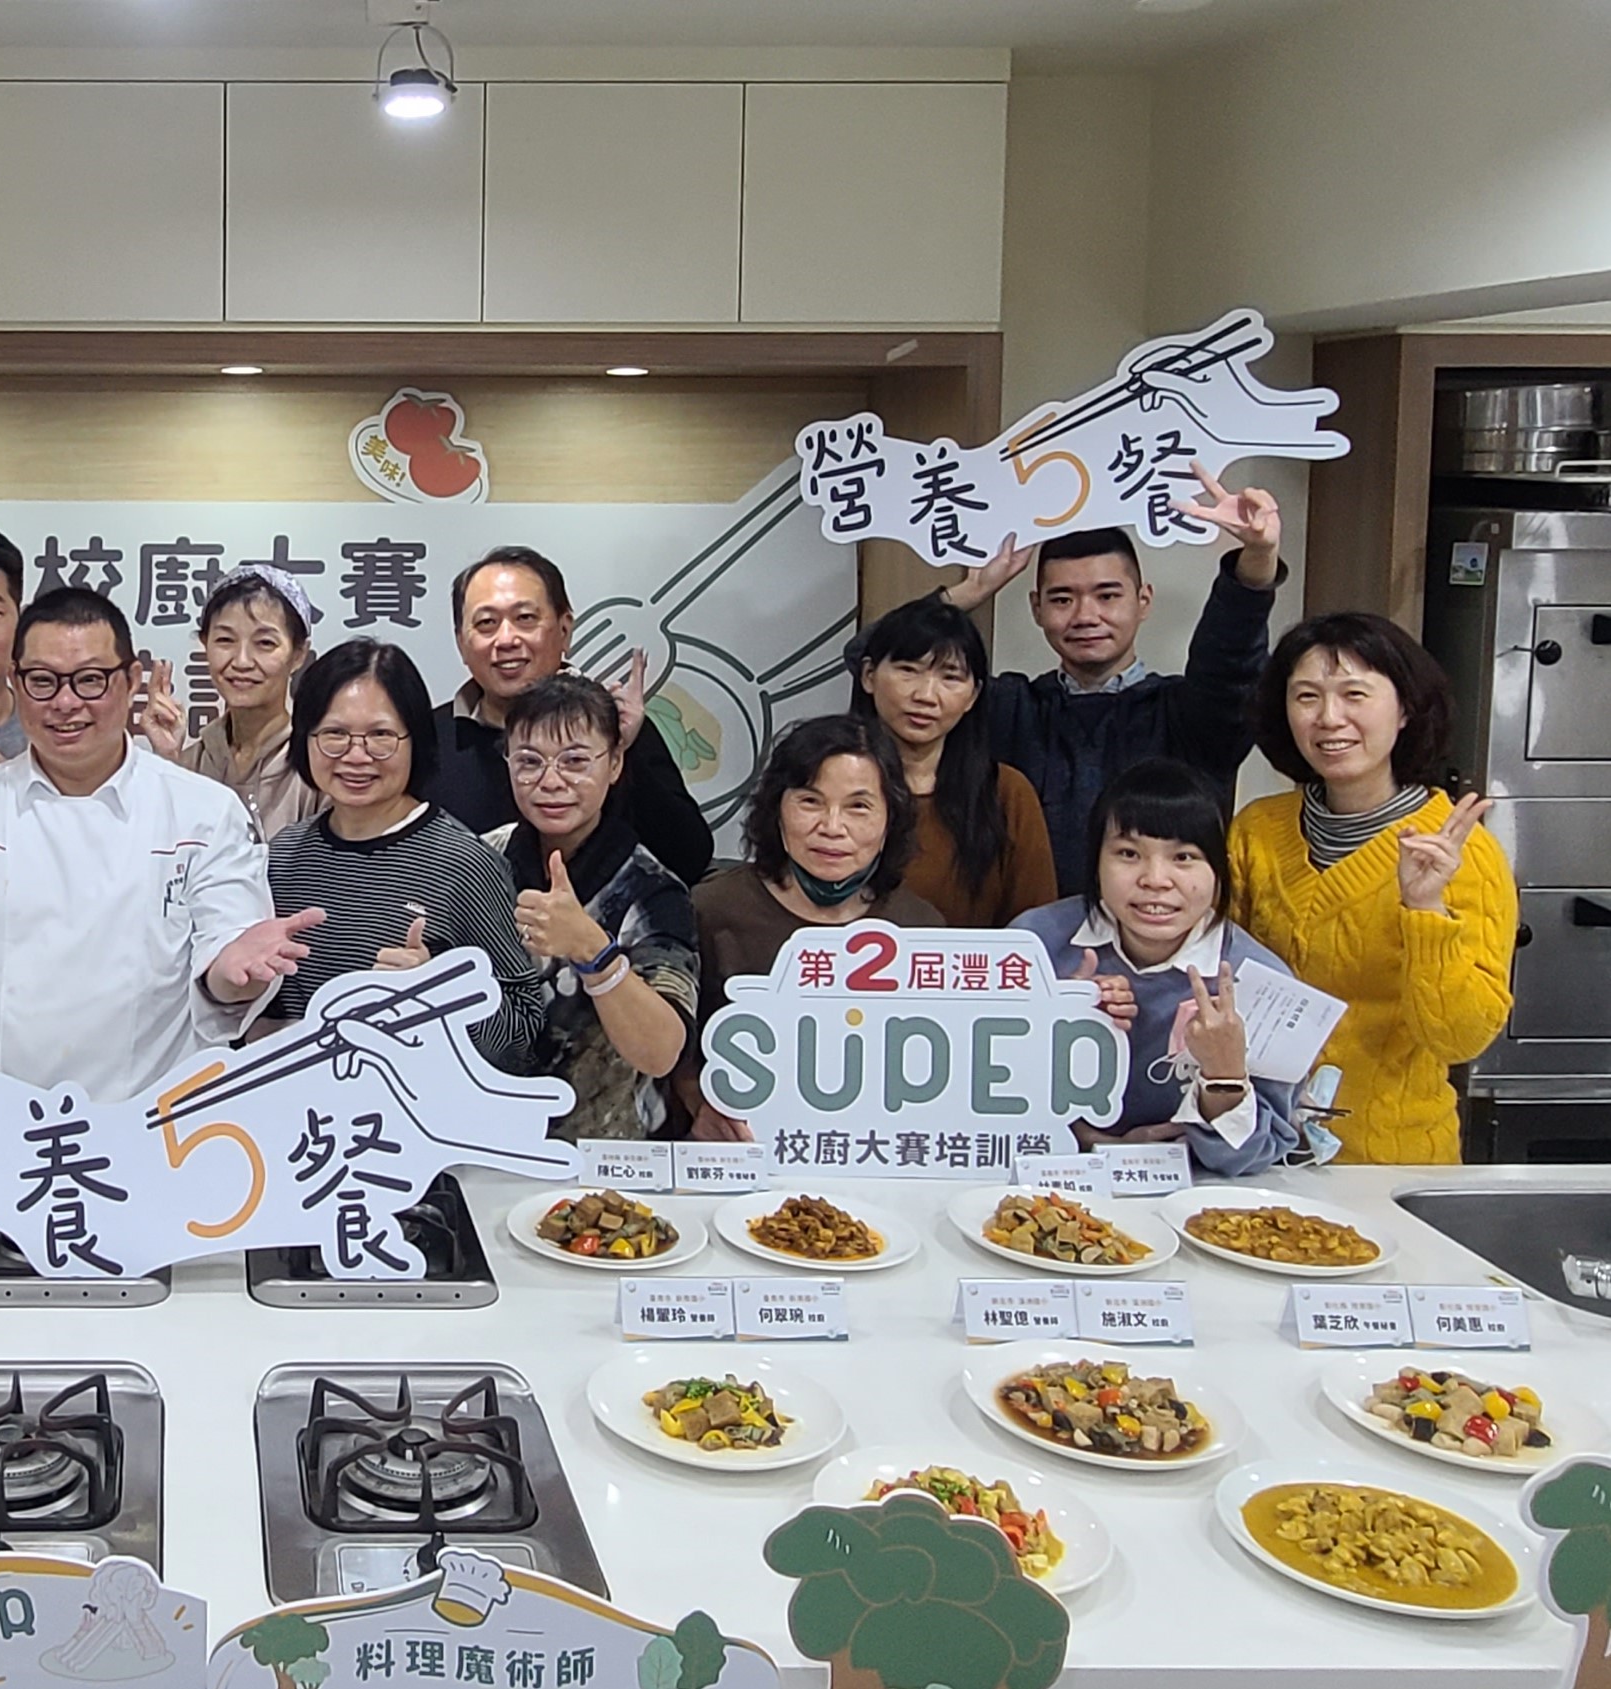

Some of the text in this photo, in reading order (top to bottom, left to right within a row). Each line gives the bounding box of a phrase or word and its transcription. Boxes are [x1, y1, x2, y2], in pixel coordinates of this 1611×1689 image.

[361, 434, 405, 488] 美味!
[805, 411, 1207, 559] 營養5餐
[797, 931, 1033, 991] 第2屆灃食
[710, 1008, 1114, 1117] SUPER
[355, 1639, 596, 1688] 料理魔術師
